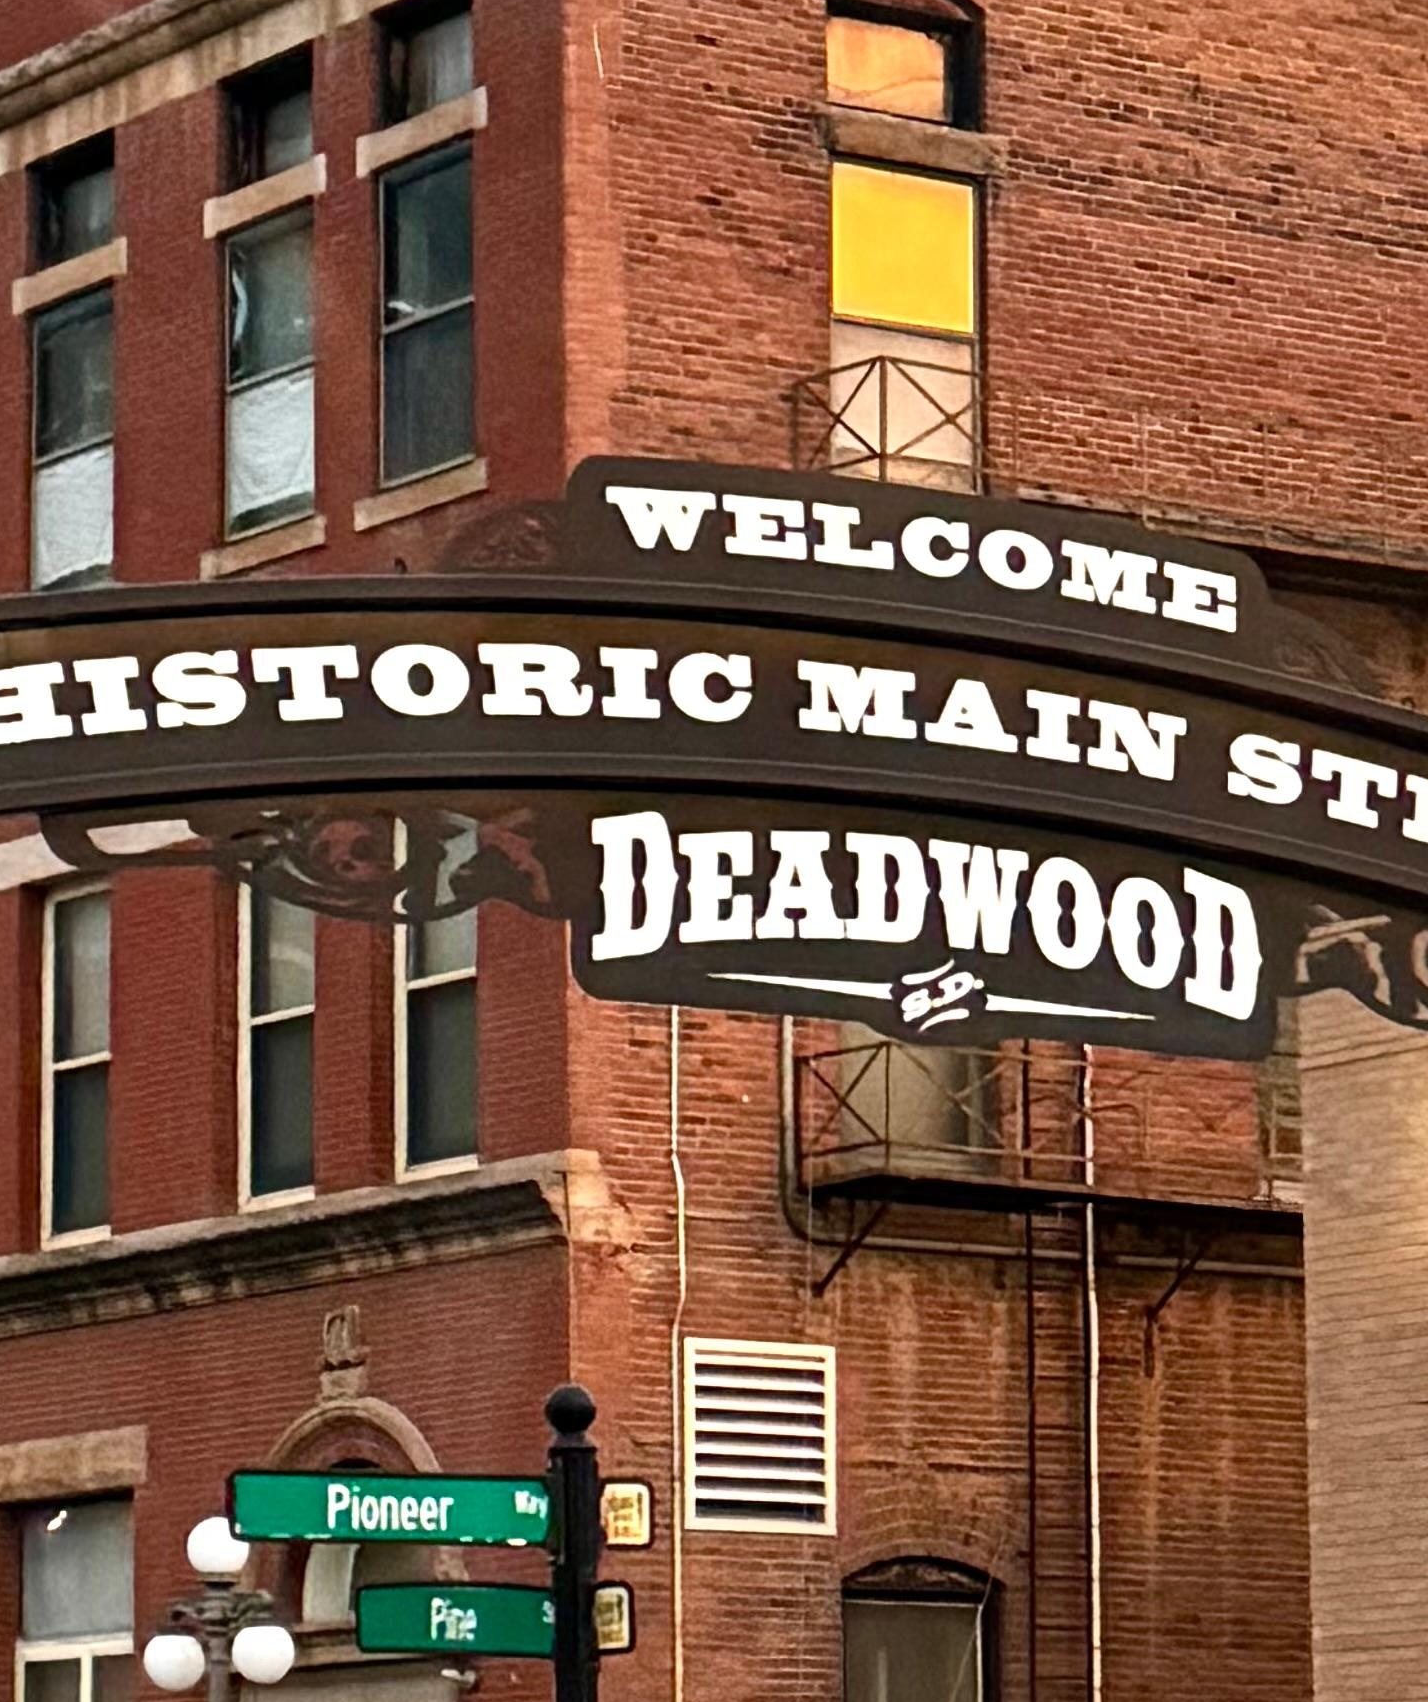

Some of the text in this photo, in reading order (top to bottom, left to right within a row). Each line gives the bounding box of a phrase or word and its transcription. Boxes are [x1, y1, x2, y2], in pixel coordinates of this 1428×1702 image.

[604, 485, 1238, 634] WELCOME
[796, 658, 1188, 782] MAIN
[590, 810, 1264, 1021] DEADWOOD
[900, 970, 985, 1023] S.D.
[327, 1483, 454, 1531] Pioneer
[430, 1597, 478, 1641] Pine
